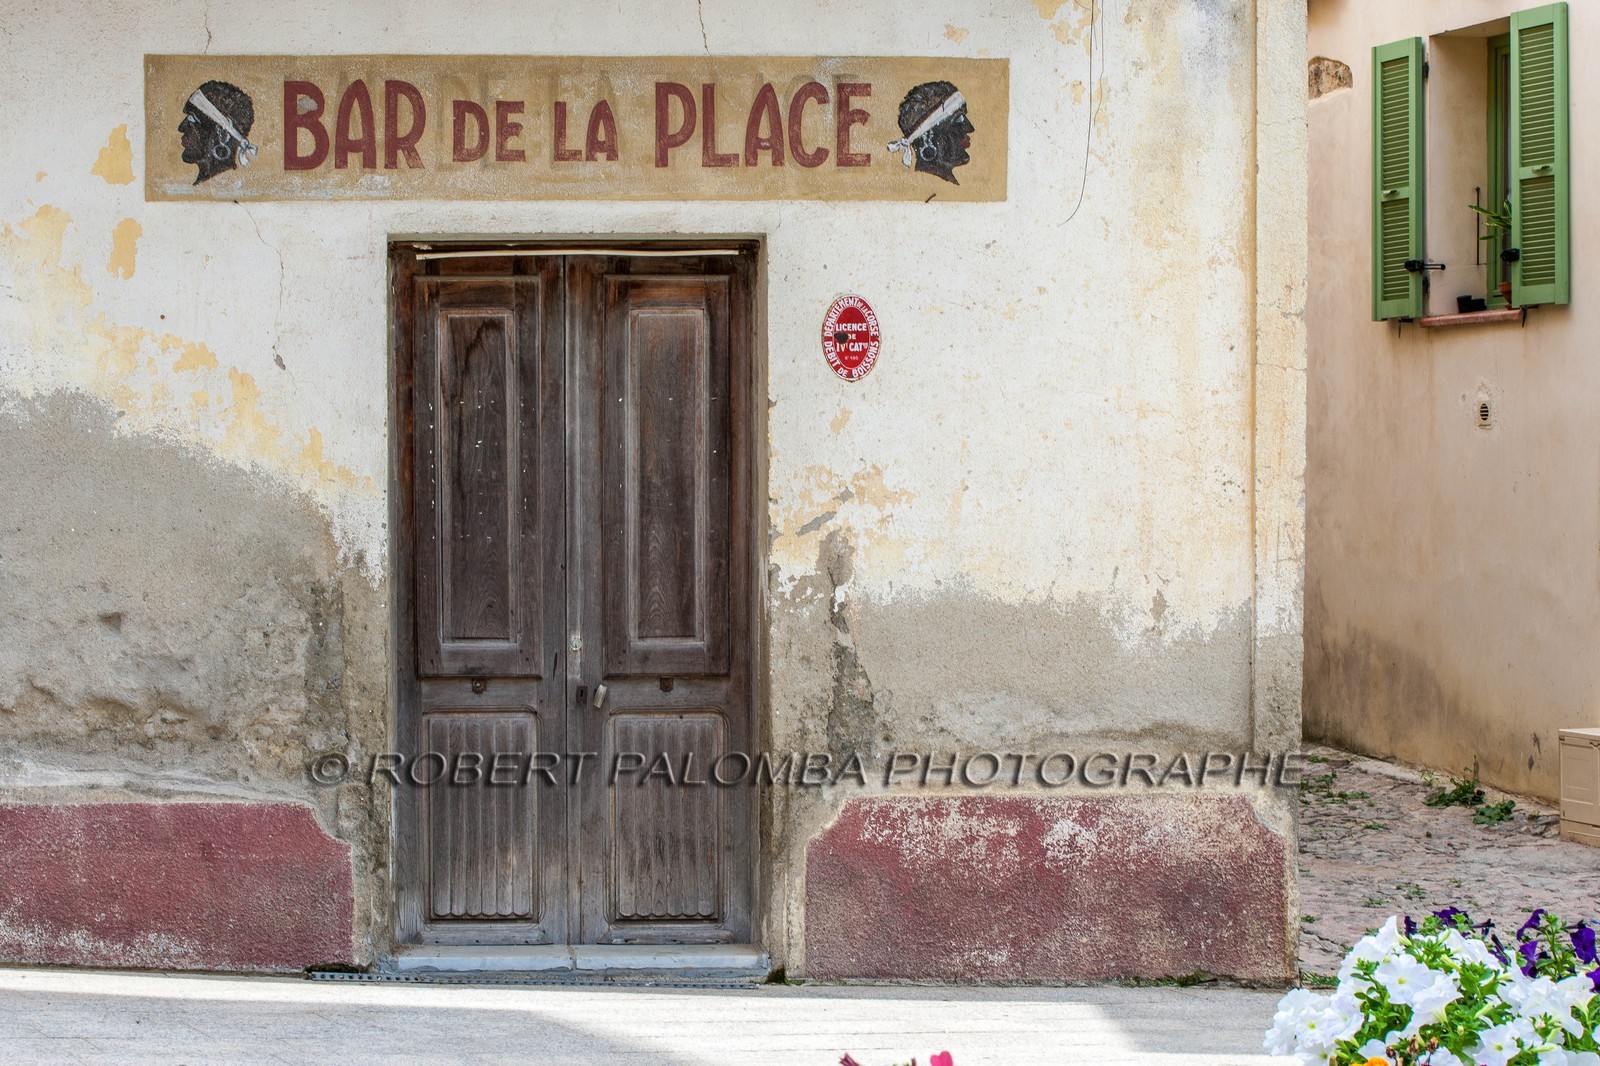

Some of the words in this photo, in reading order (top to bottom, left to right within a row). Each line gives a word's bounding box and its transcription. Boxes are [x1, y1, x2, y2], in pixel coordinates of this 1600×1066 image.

[283, 78, 427, 170] BAR
[452, 99, 526, 163] DE
[553, 99, 619, 163] LA
[654, 80, 872, 169] PLACE
[824, 298, 859, 337] DEPARTEMENT
[866, 311, 879, 336] CORSE
[835, 323, 867, 331] LICENCE
[824, 341, 841, 366] DEBIT
[837, 367, 849, 377] DE
[852, 341, 879, 378] BOISSONS
